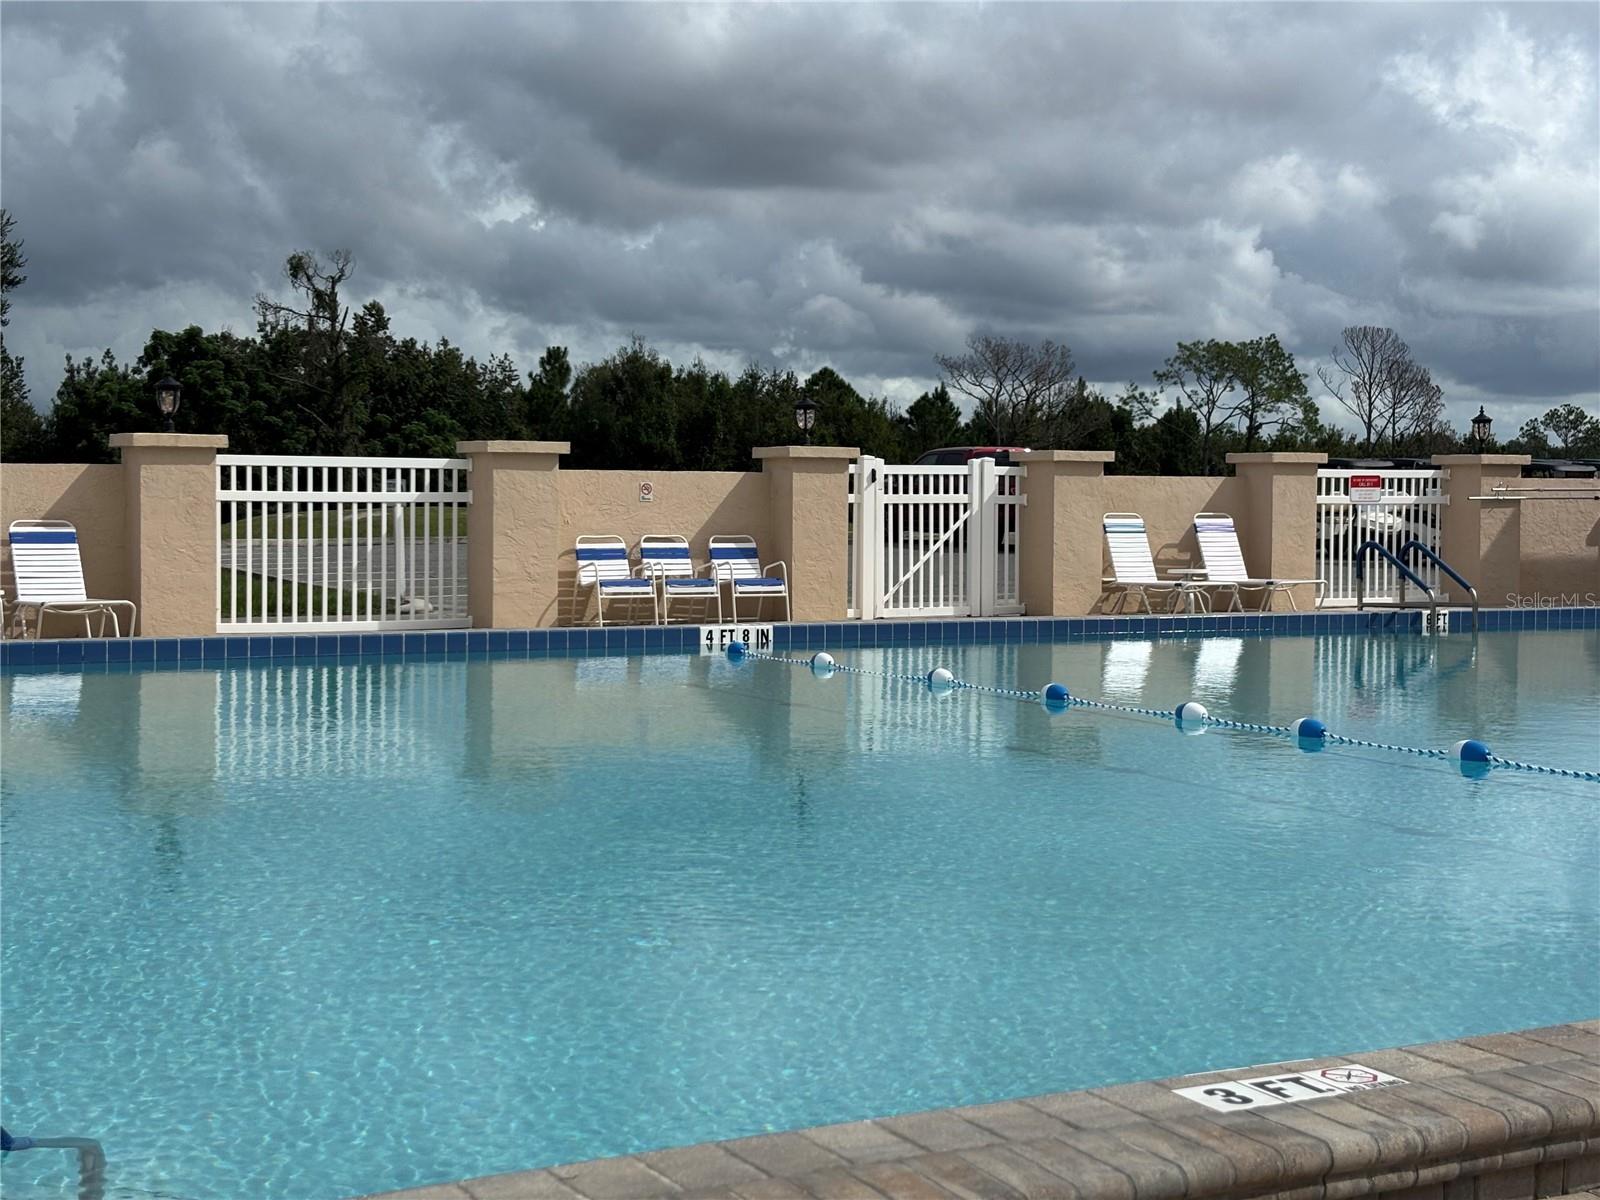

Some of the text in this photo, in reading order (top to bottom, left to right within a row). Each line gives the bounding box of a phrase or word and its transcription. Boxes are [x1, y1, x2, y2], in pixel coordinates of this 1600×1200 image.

[705, 629, 714, 643] 4
[742, 628, 750, 643] 8
[1203, 1087, 1254, 1104] 3
